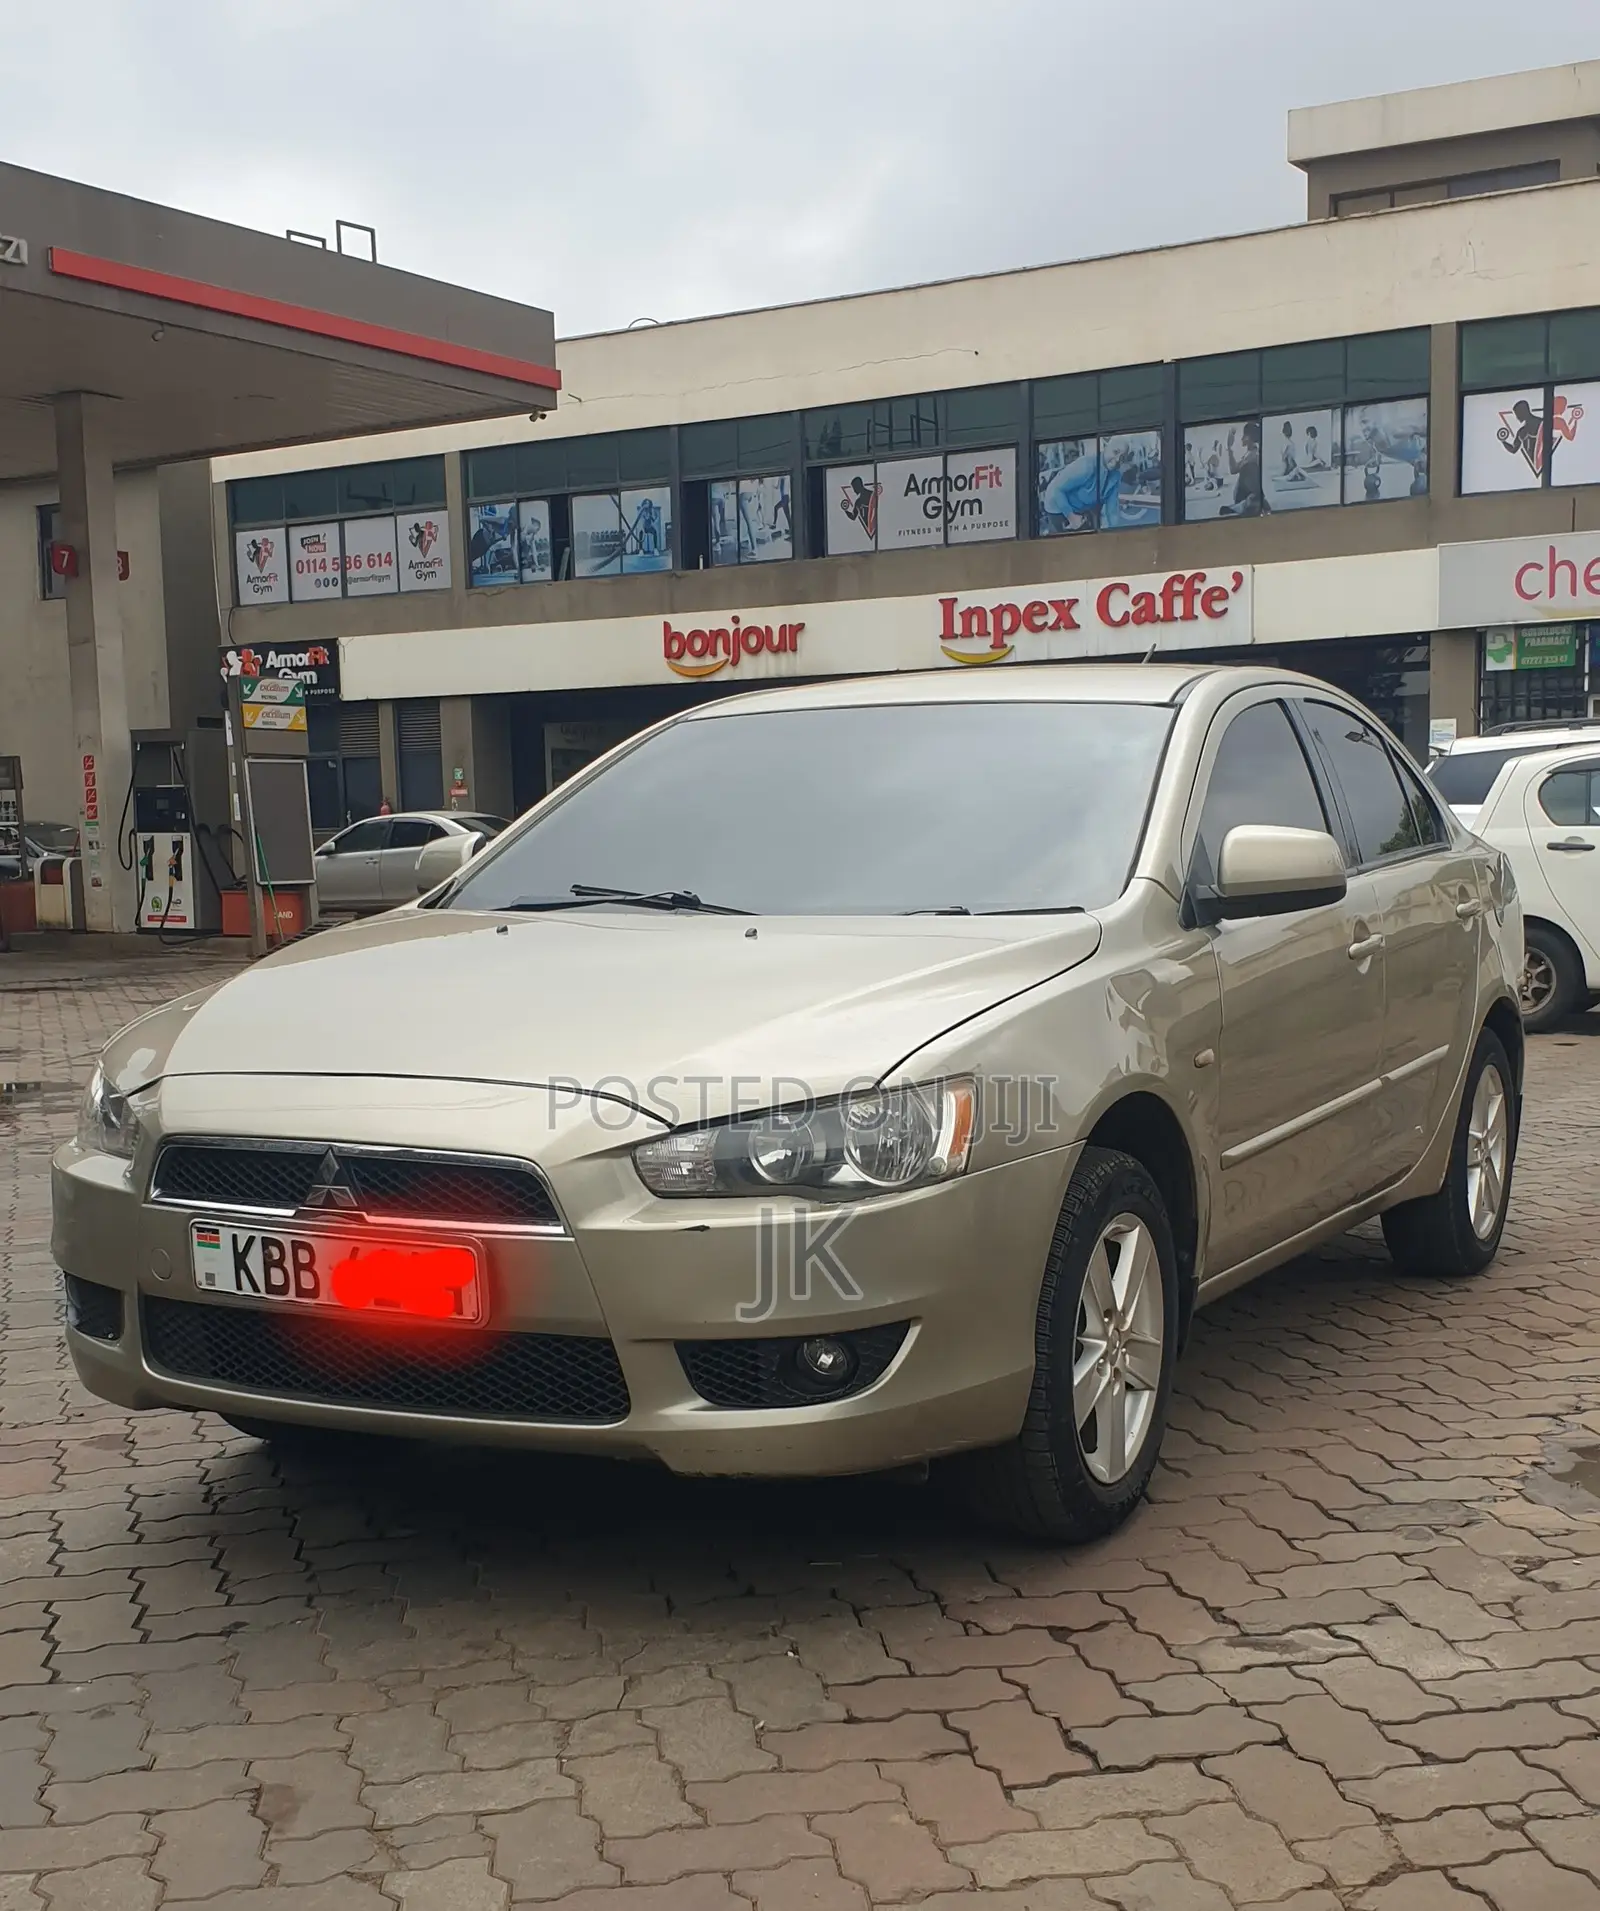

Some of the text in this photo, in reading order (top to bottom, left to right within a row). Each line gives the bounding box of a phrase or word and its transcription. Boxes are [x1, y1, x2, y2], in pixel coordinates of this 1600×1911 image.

[903, 464, 1002, 497] ArmorFit
[922, 496, 983, 524] Gym
[898, 527, 932, 536] FITNESS
[935, 525, 959, 533] WTH
[971, 520, 1009, 530] PURPOSE
[303, 535, 319, 546] JOIN
[308, 544, 325, 552] NOW
[60, 549, 70, 569] 7
[296, 557, 327, 574] 0114
[367, 552, 393, 568] 614
[408, 557, 443, 570] ArmorFit
[246, 572, 279, 585] ArmorFit
[415, 570, 437, 581] Gym
[252, 584, 273, 595] Gym
[938, 597, 1081, 649] Inpex
[663, 615, 806, 667] bonjour
[265, 646, 330, 669] ArmorFit
[231, 1233, 321, 1299] KBB
